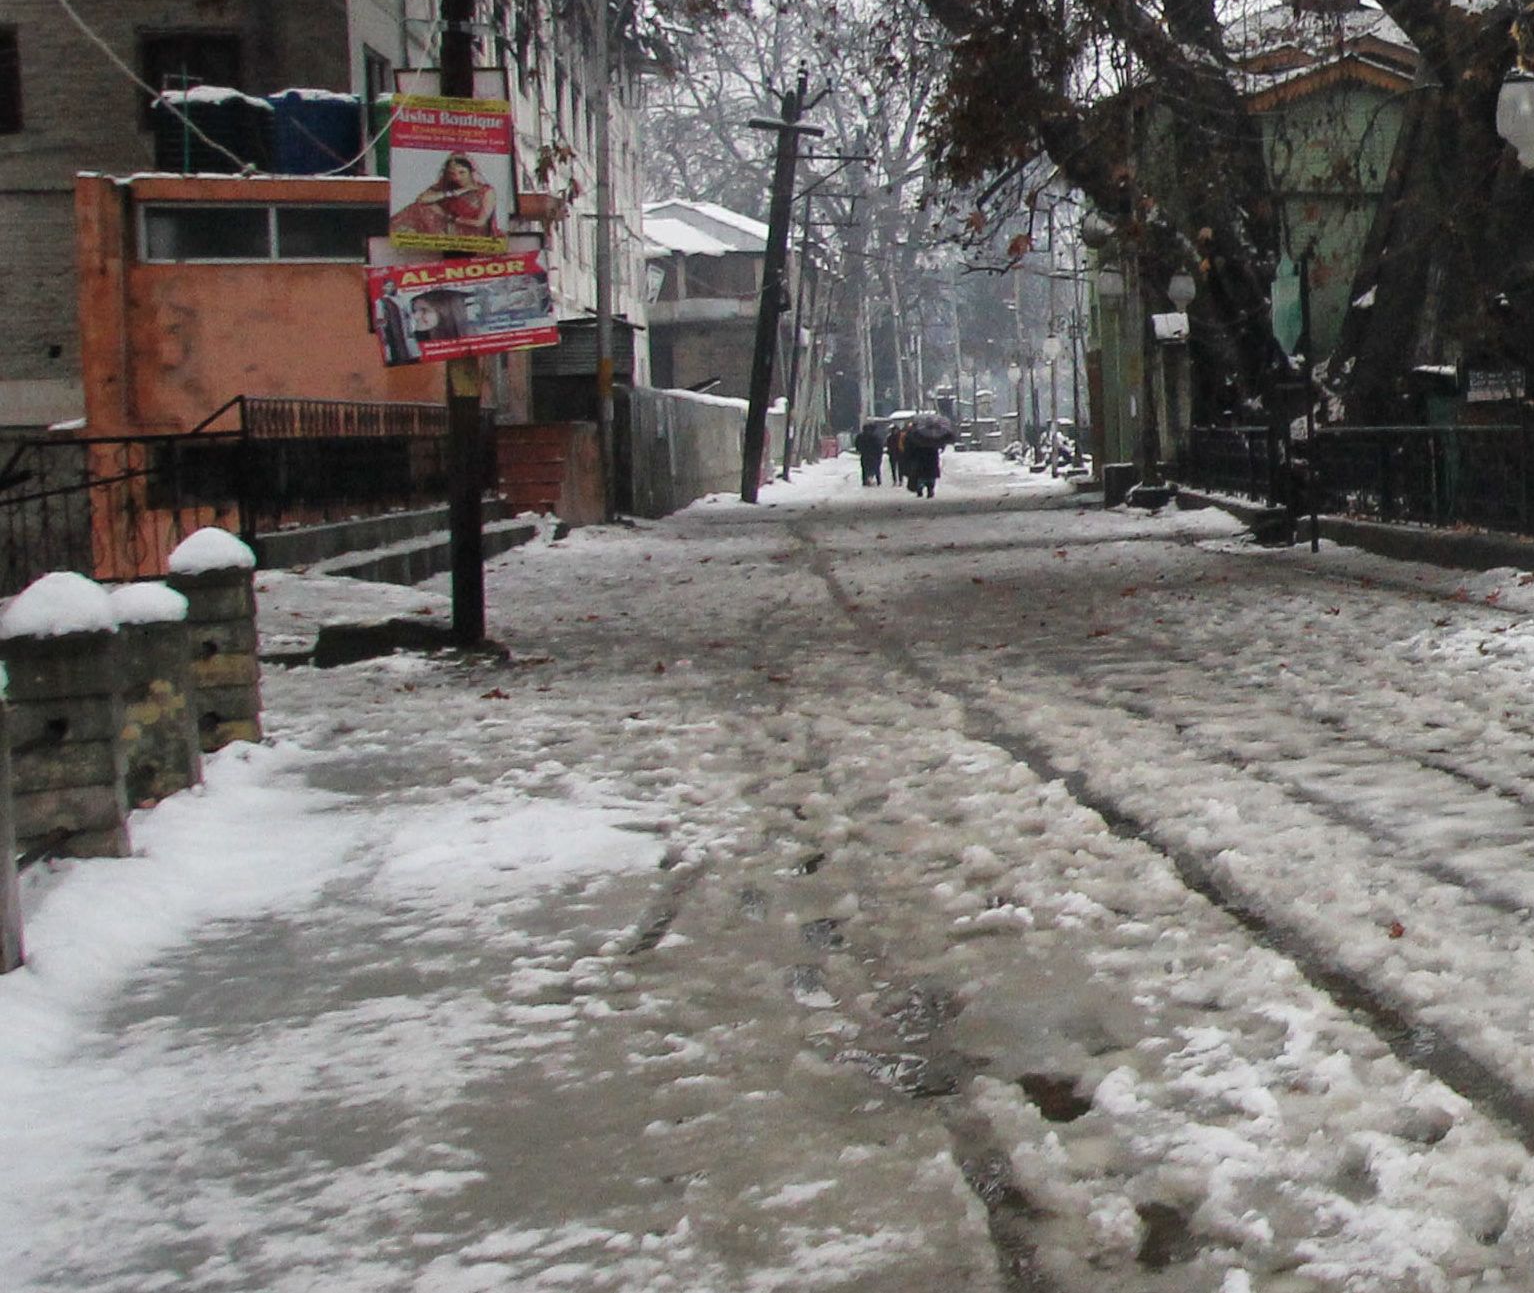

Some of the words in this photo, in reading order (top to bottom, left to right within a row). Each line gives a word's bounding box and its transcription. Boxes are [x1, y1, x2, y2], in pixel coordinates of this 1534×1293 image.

[397, 109, 435, 124] Aisha
[440, 111, 503, 130] Boutique
[401, 260, 525, 285] AL-NOOR
